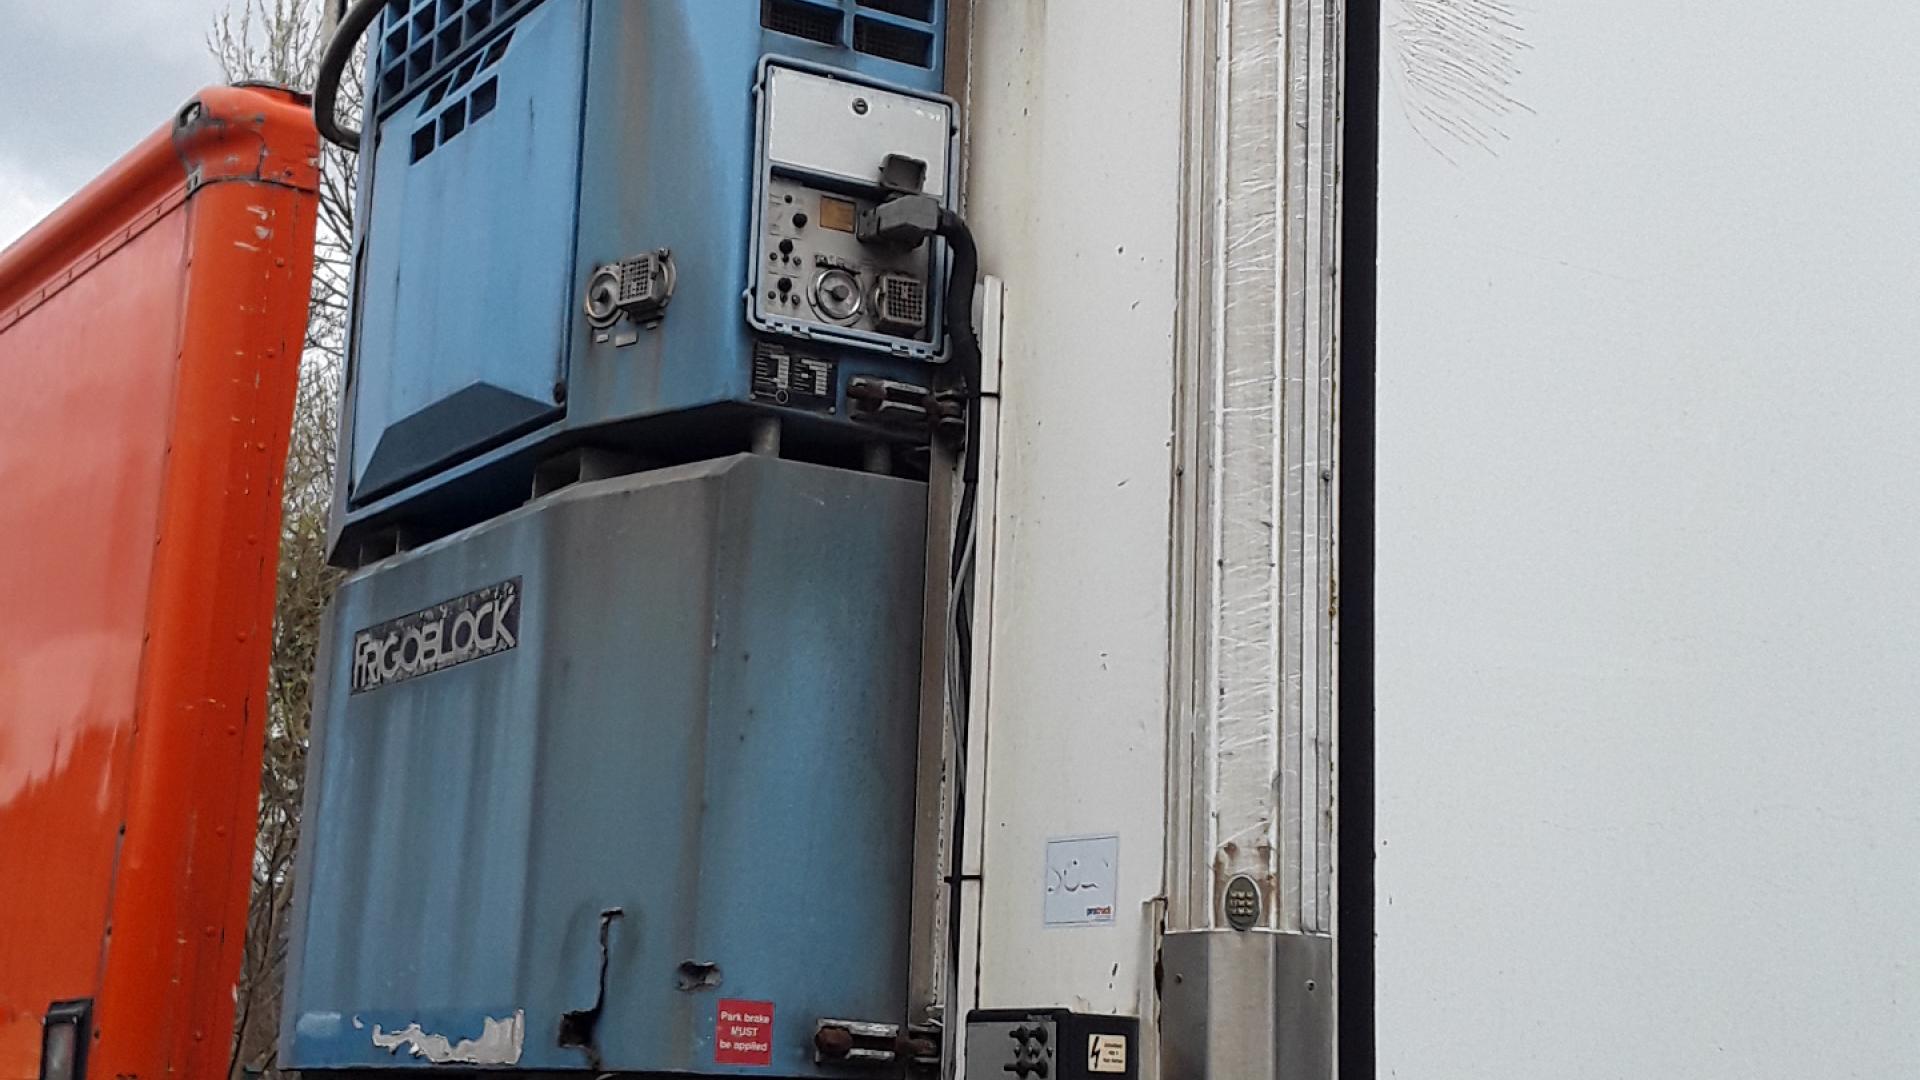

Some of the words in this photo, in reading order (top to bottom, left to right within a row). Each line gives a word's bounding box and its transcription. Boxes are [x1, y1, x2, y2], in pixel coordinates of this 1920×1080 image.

[353, 594, 516, 688] FRIGOBLOCK
[720, 1010, 742, 1021] Park
[743, 1012, 770, 1023] brake
[730, 1026, 758, 1036] MUST
[720, 1039, 732, 1049] be
[733, 1041, 768, 1052] applied
